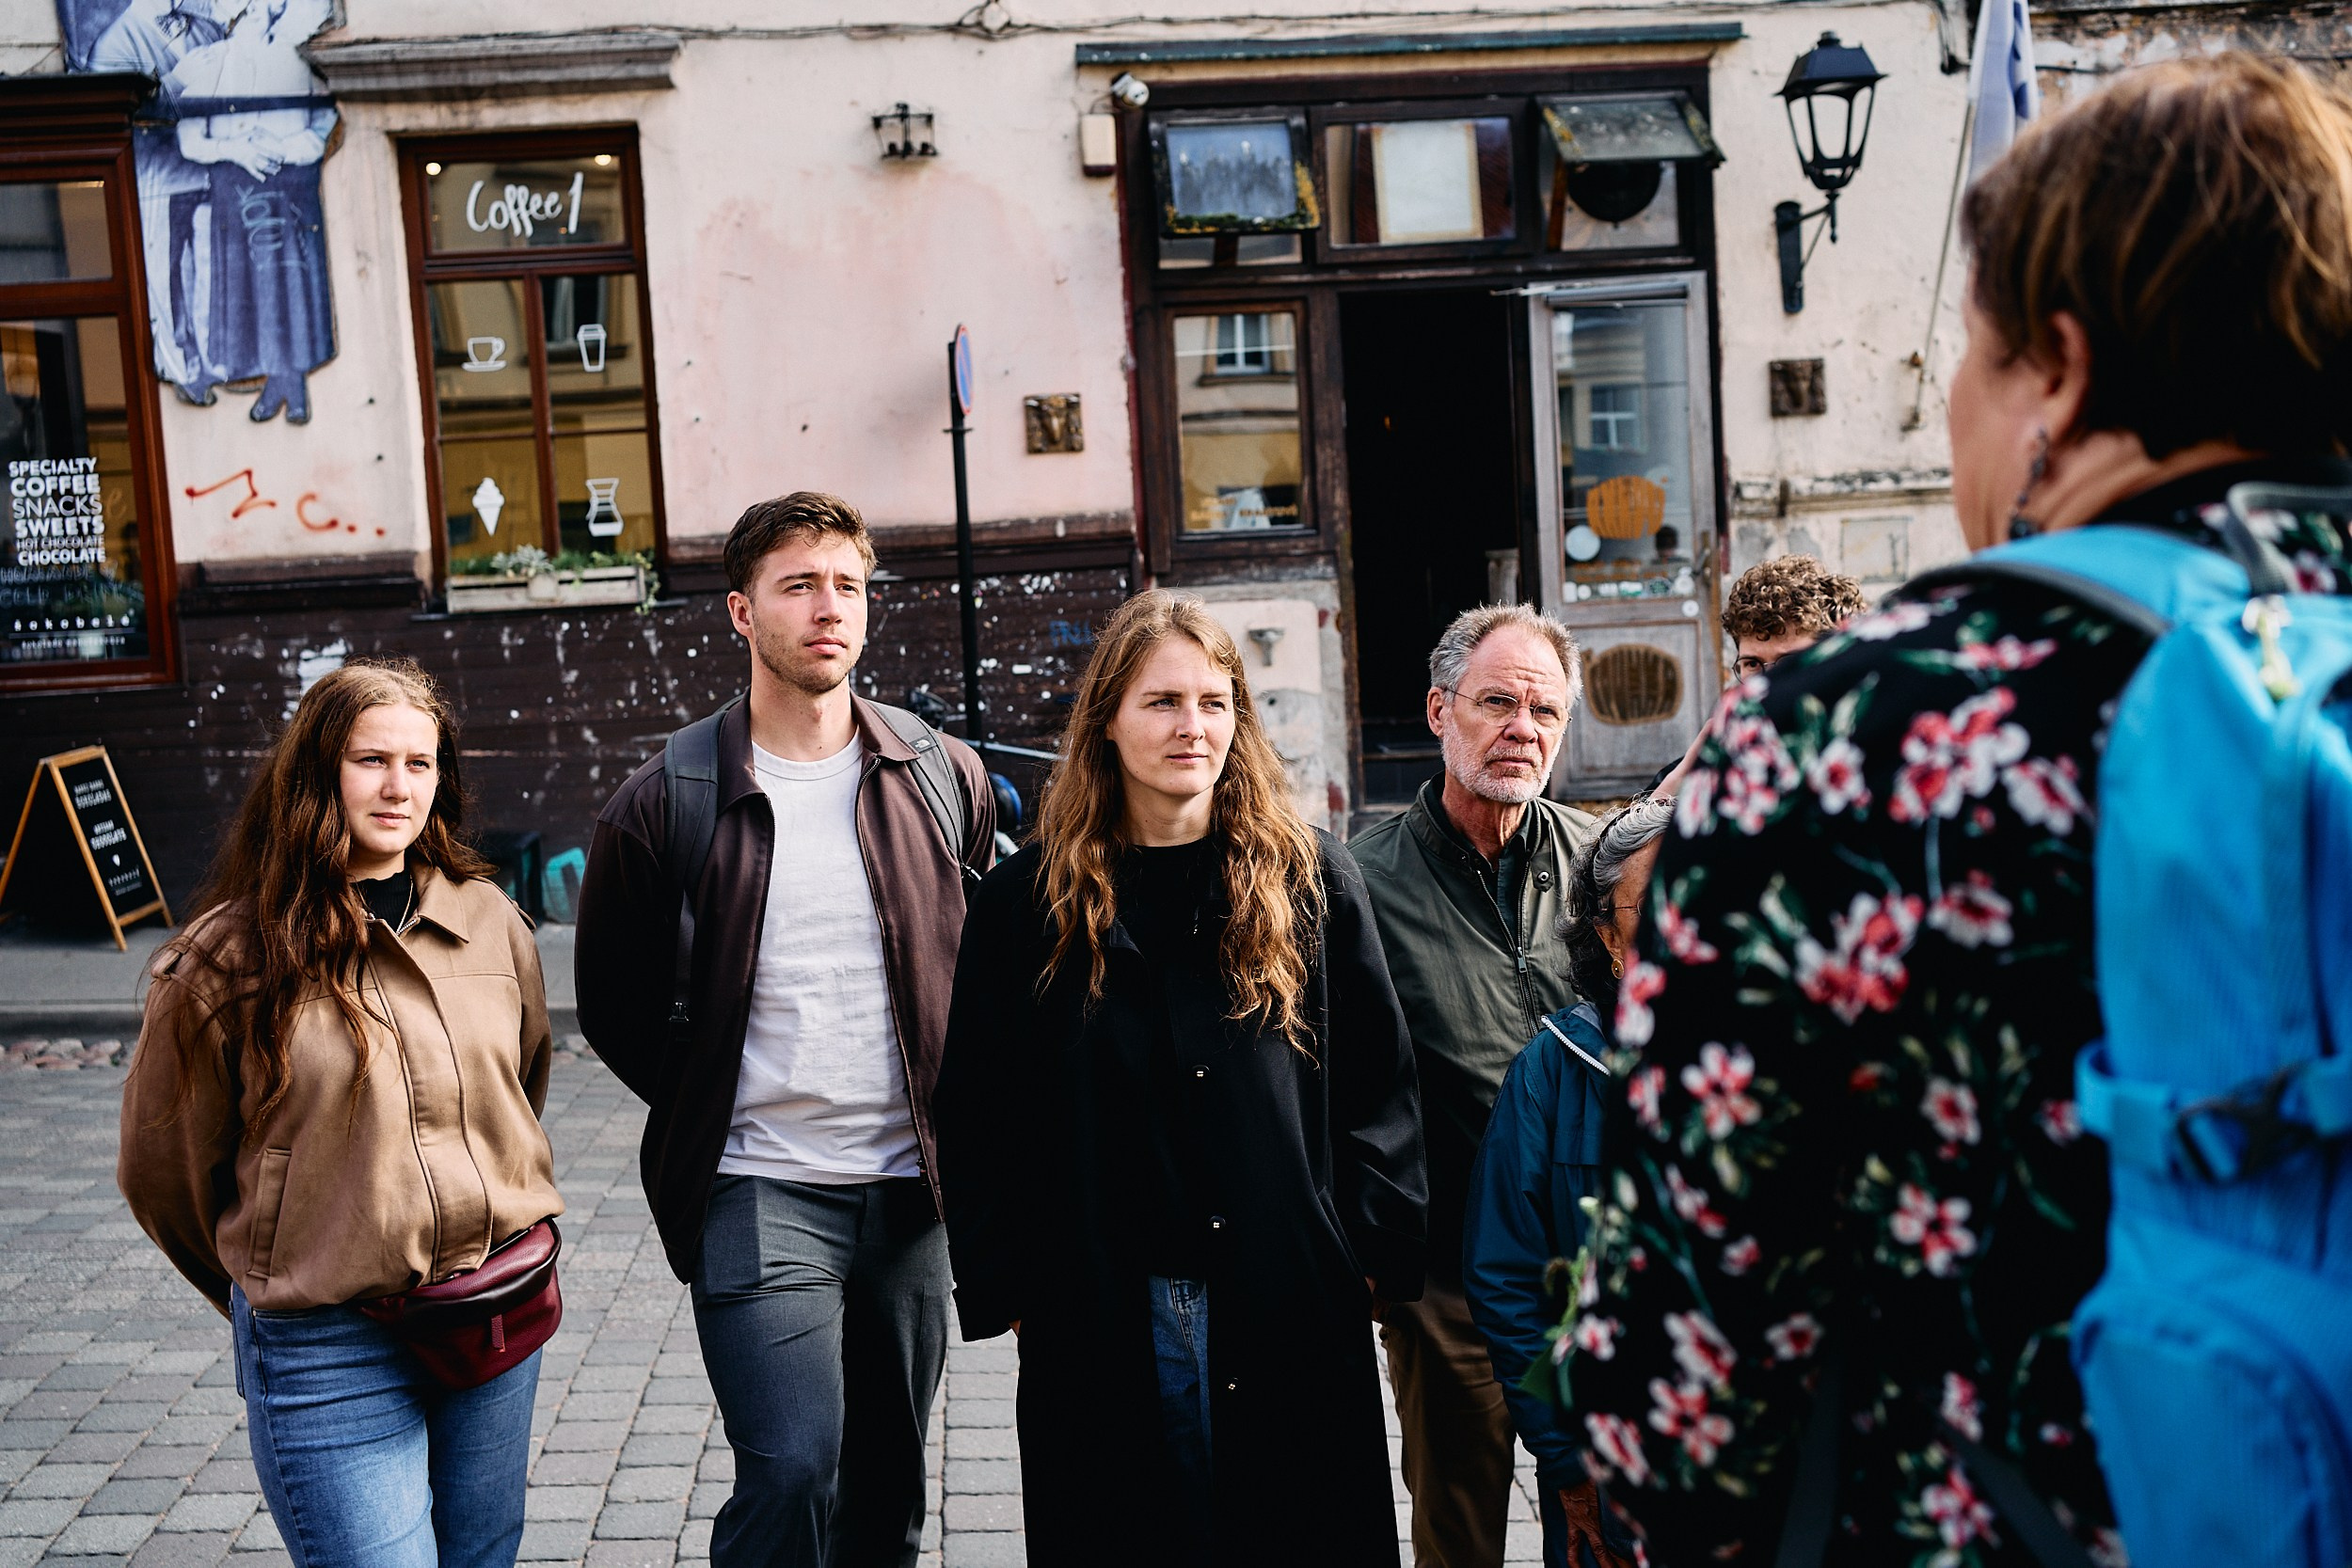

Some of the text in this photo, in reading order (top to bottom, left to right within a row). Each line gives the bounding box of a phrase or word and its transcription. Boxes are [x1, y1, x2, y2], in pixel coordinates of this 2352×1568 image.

[466, 180, 563, 238] Coffee
[8, 457, 97, 478] SPECIALTY
[10, 473, 101, 499] COFFEE
[12, 494, 103, 519] SNACKS
[15, 515, 104, 540] SWEETS
[16, 534, 104, 552] HOT CHOCOLATE
[19, 546, 106, 566] CHOCOLATE
